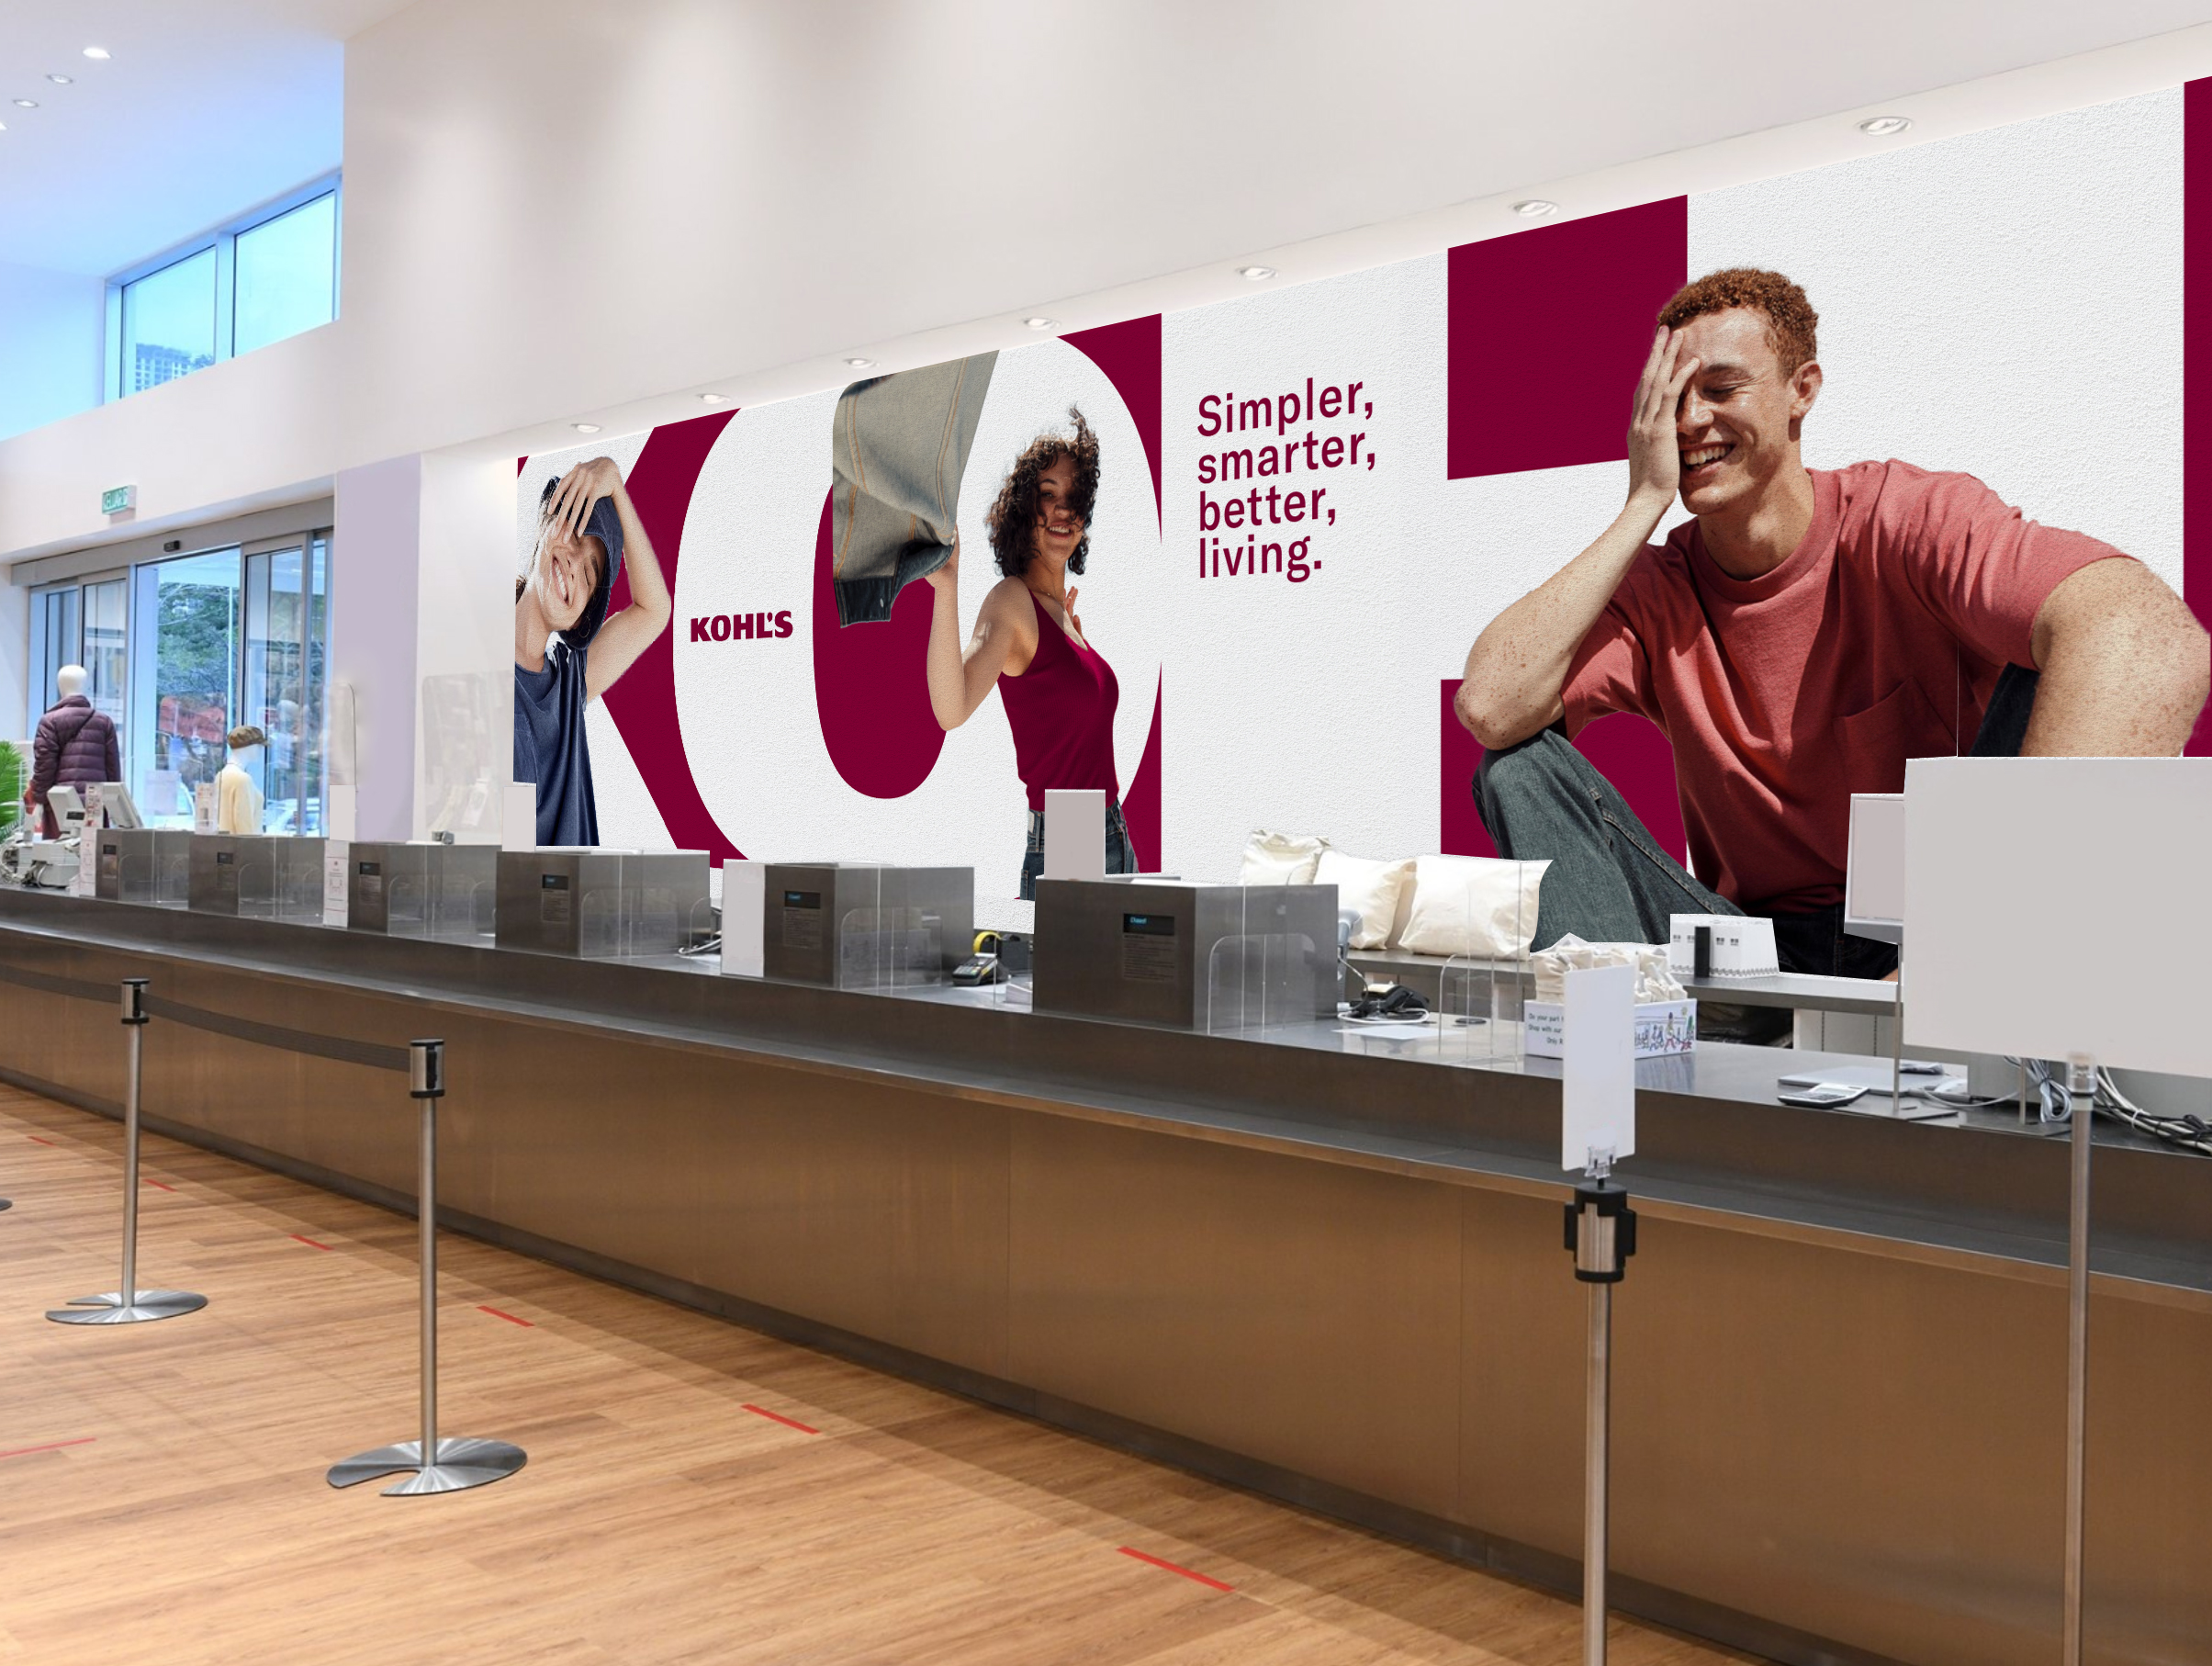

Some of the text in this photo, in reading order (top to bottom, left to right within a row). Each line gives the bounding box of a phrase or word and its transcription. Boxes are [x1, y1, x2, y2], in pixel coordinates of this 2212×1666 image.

[1197, 377, 1373, 436] Simpler,
[1197, 431, 1375, 484] smarter,
[1199, 485, 1336, 531] better,
[1199, 534, 1322, 583] living.
[691, 610, 793, 642] KOHL'S
